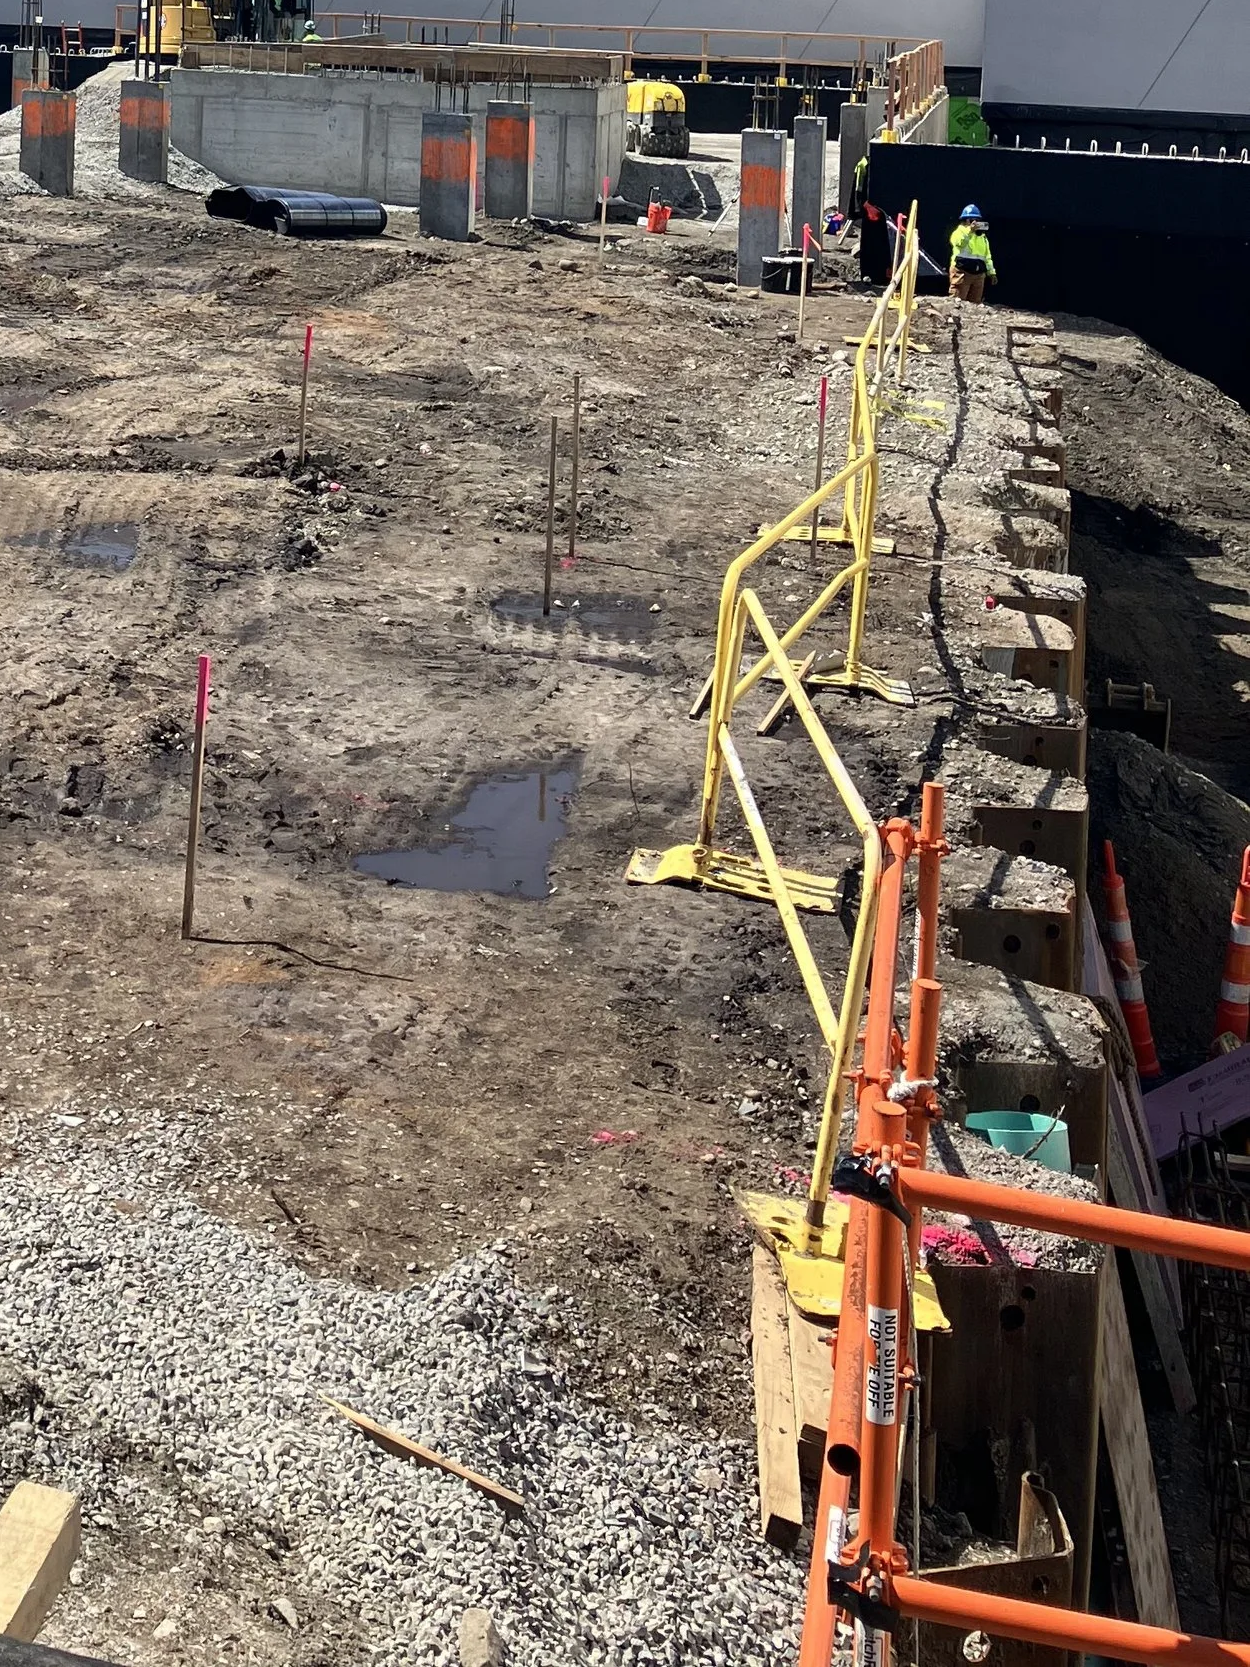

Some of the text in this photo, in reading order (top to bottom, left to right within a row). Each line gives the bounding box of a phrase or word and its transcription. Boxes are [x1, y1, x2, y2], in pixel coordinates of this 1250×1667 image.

[868, 1379, 881, 1409] OFF
[883, 1314, 897, 1418] NOT SUITABLE
